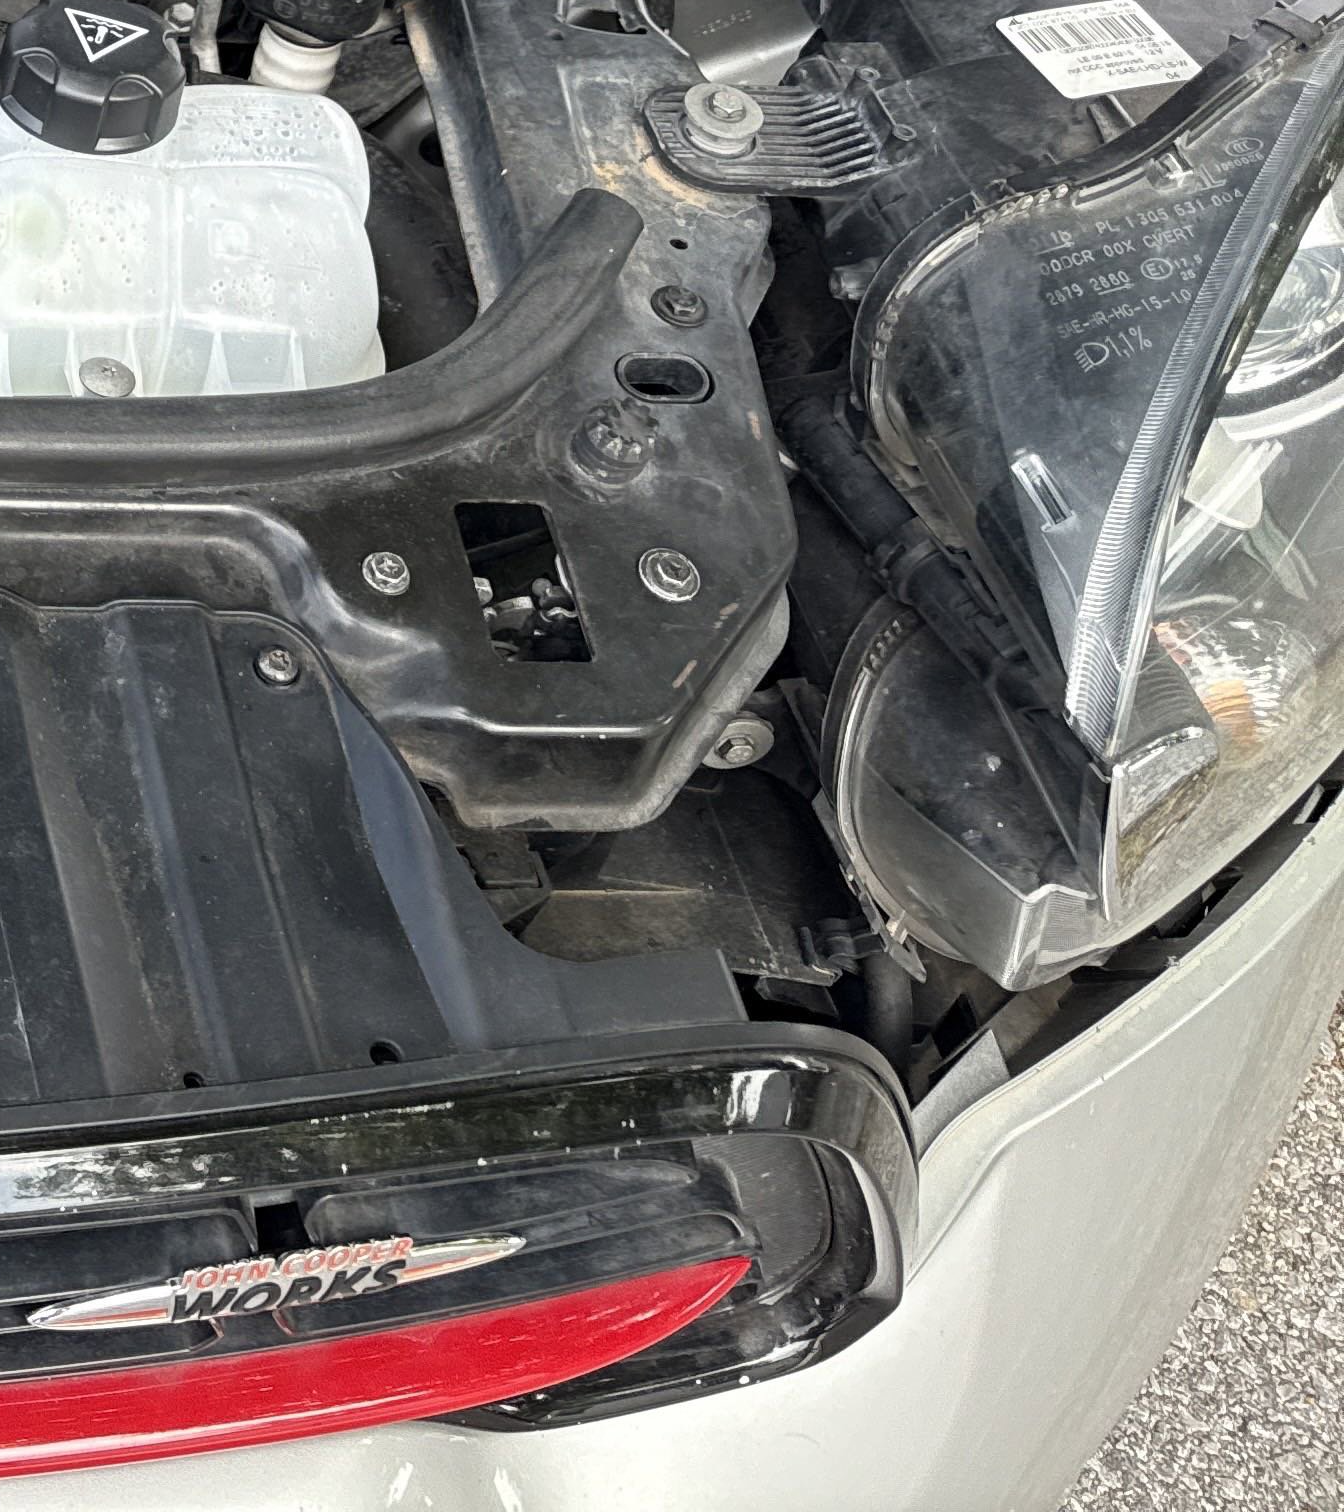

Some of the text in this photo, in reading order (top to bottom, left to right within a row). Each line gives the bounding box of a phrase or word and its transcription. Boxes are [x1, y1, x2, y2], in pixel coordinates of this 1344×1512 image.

[1095, 220, 1121, 235] PL
[1137, 207, 1170, 226] 305
[1102, 239, 1137, 259] 00X
[1143, 224, 1196, 250] CVERT
[1045, 282, 1085, 307] 2879
[1089, 269, 1131, 292] 2880
[1105, 324, 1154, 360] 1,1%
[181, 1236, 413, 1289] JOHN COOPER
[173, 1259, 407, 1322] WORKS
